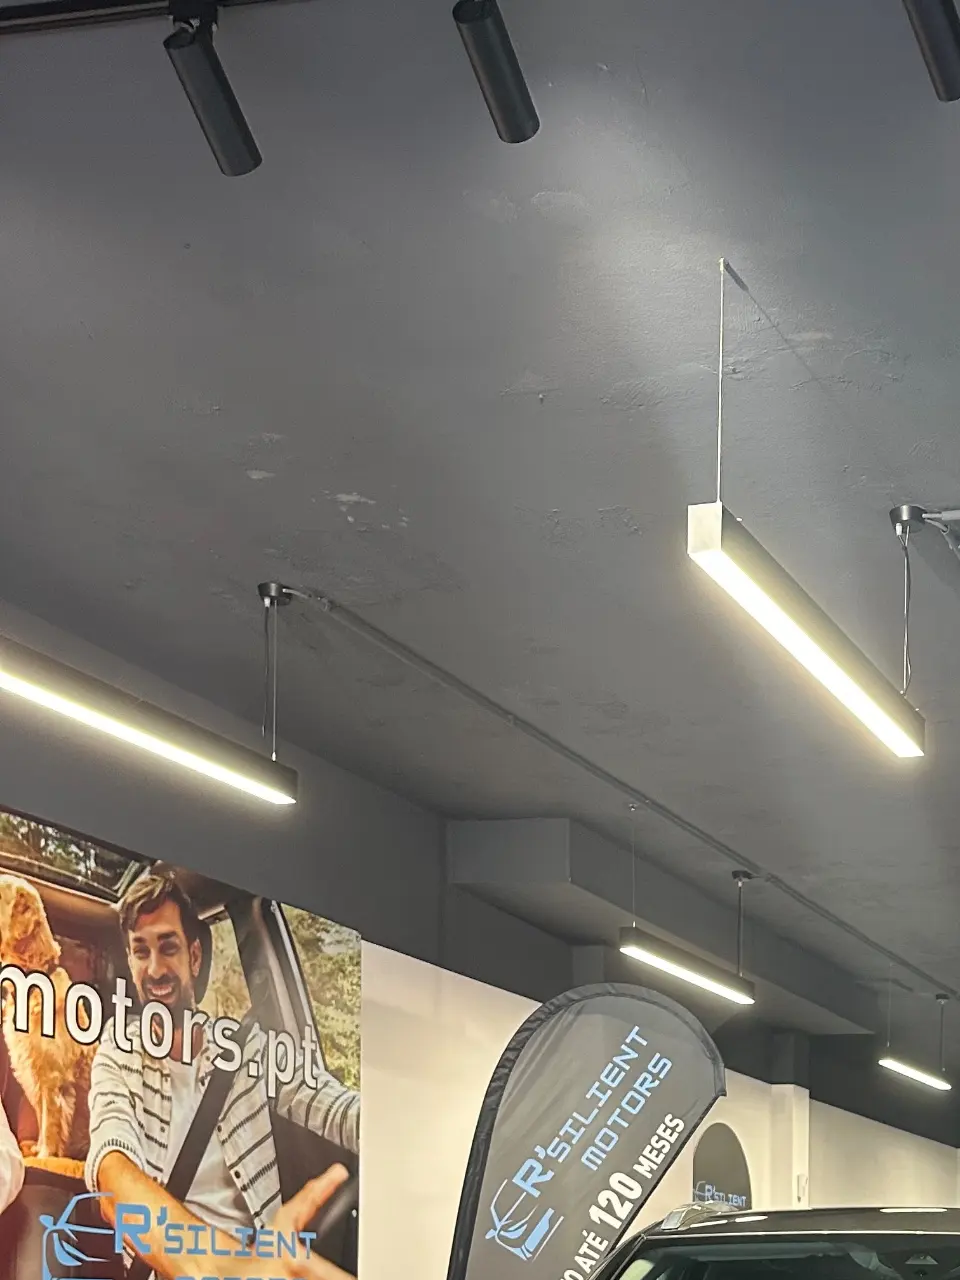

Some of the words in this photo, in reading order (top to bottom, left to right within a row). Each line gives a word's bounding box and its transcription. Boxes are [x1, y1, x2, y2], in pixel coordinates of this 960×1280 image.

[511, 1025, 649, 1198] R'SILIENT
[580, 1052, 674, 1172] MOTORS
[632, 1113, 686, 1180] MESES
[114, 1203, 318, 1260] R'SILIENT
[589, 1171, 643, 1230] 120
[573, 1230, 610, 1276] ATÉ
